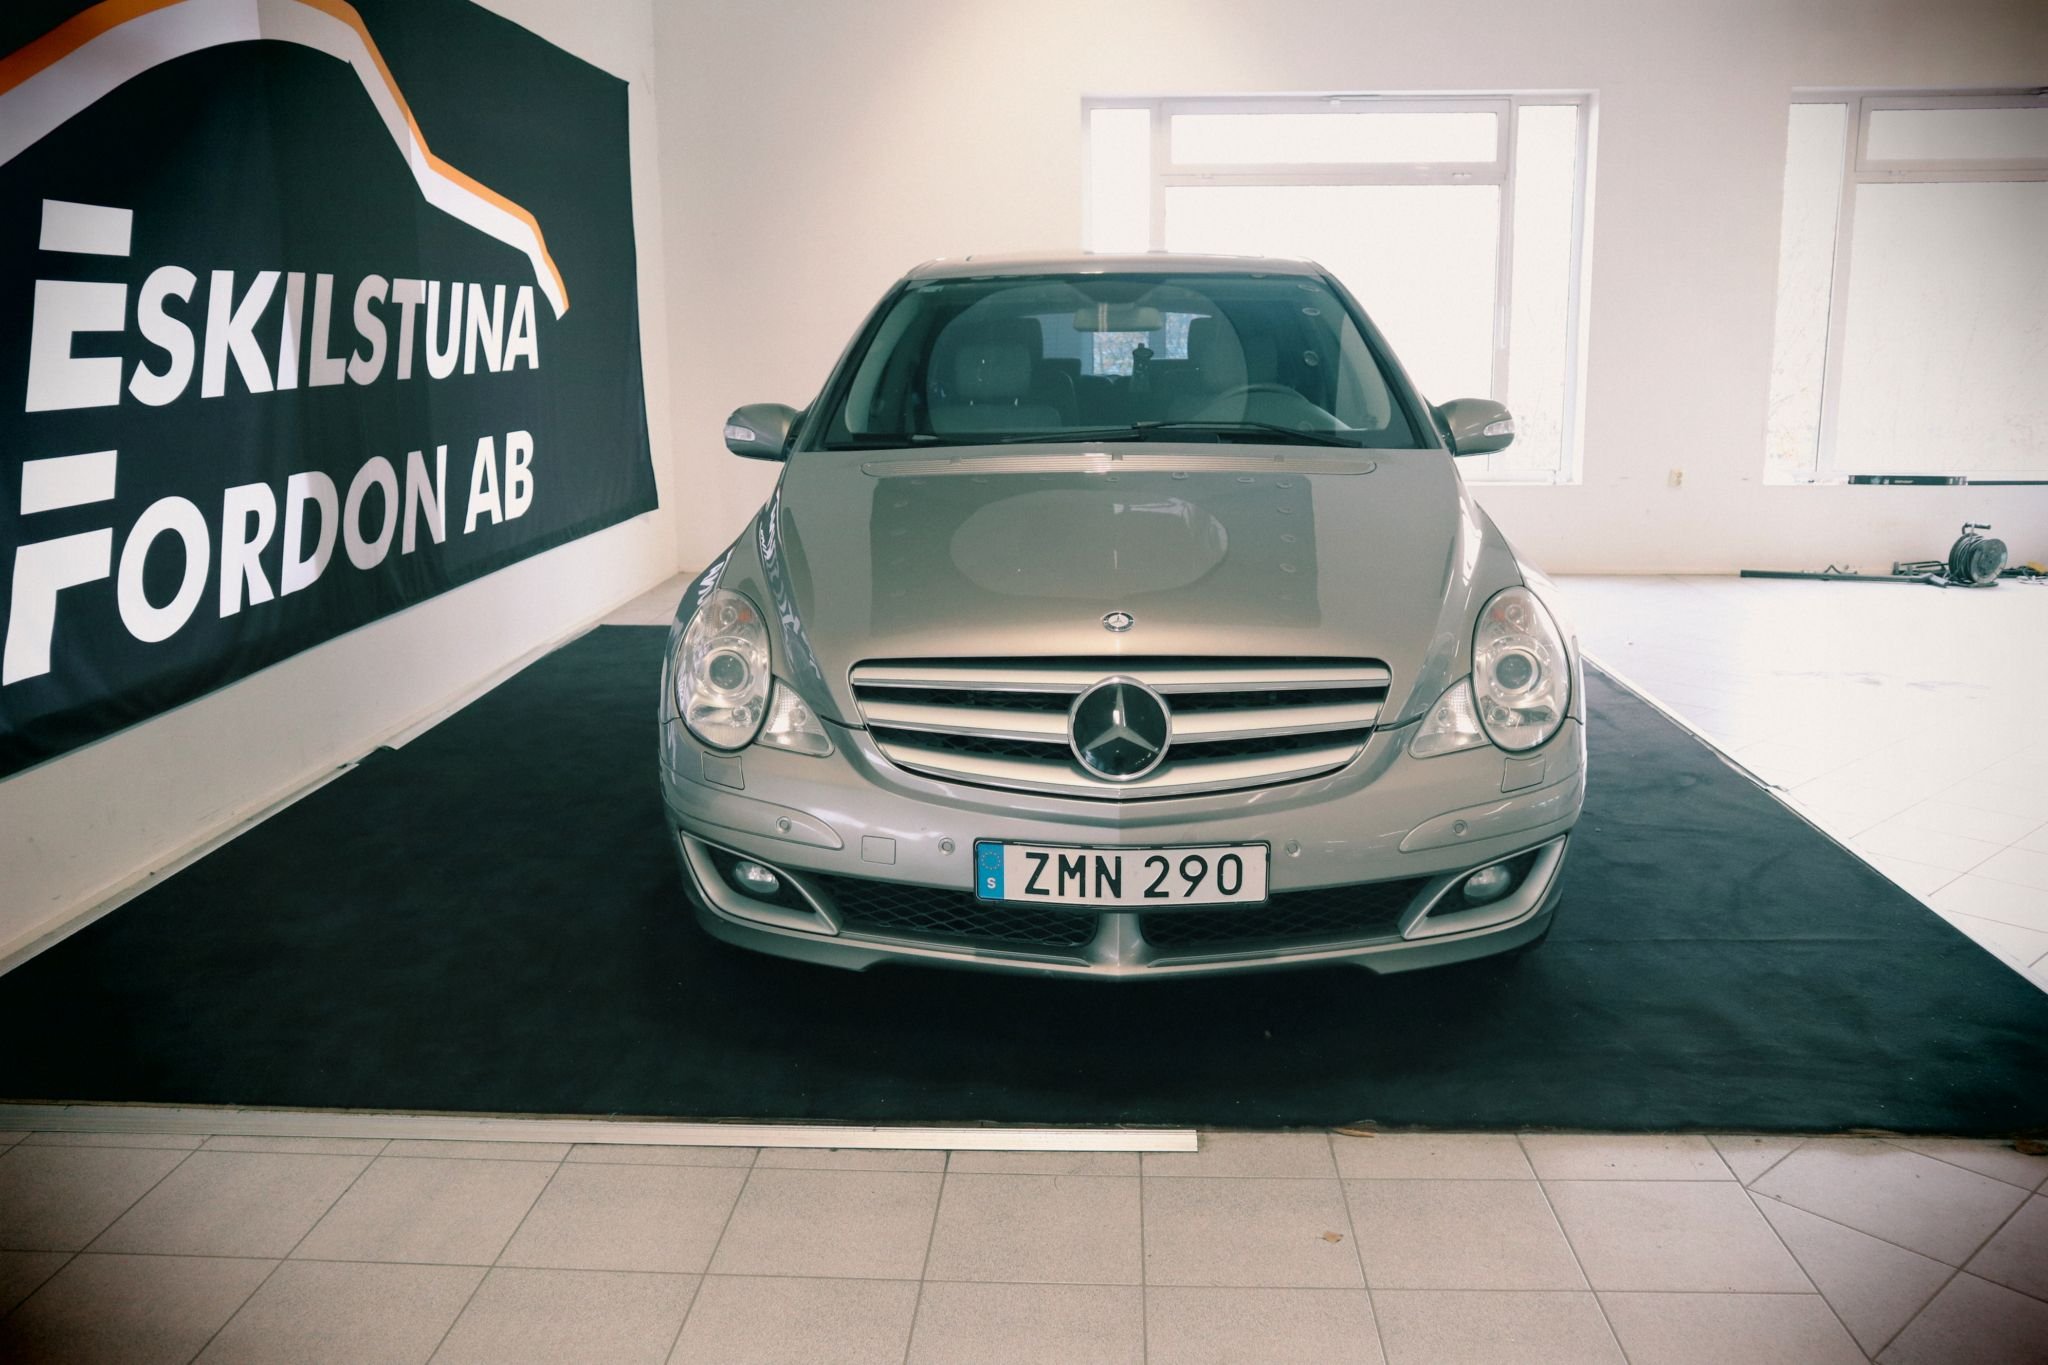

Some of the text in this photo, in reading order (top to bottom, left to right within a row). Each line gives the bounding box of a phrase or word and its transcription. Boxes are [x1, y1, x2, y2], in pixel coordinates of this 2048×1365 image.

[26, 199, 539, 412] ESKILSTUNA
[3, 431, 534, 686] FORDON AB
[986, 877, 996, 889] S
[1025, 852, 1243, 898] ZMN 290
